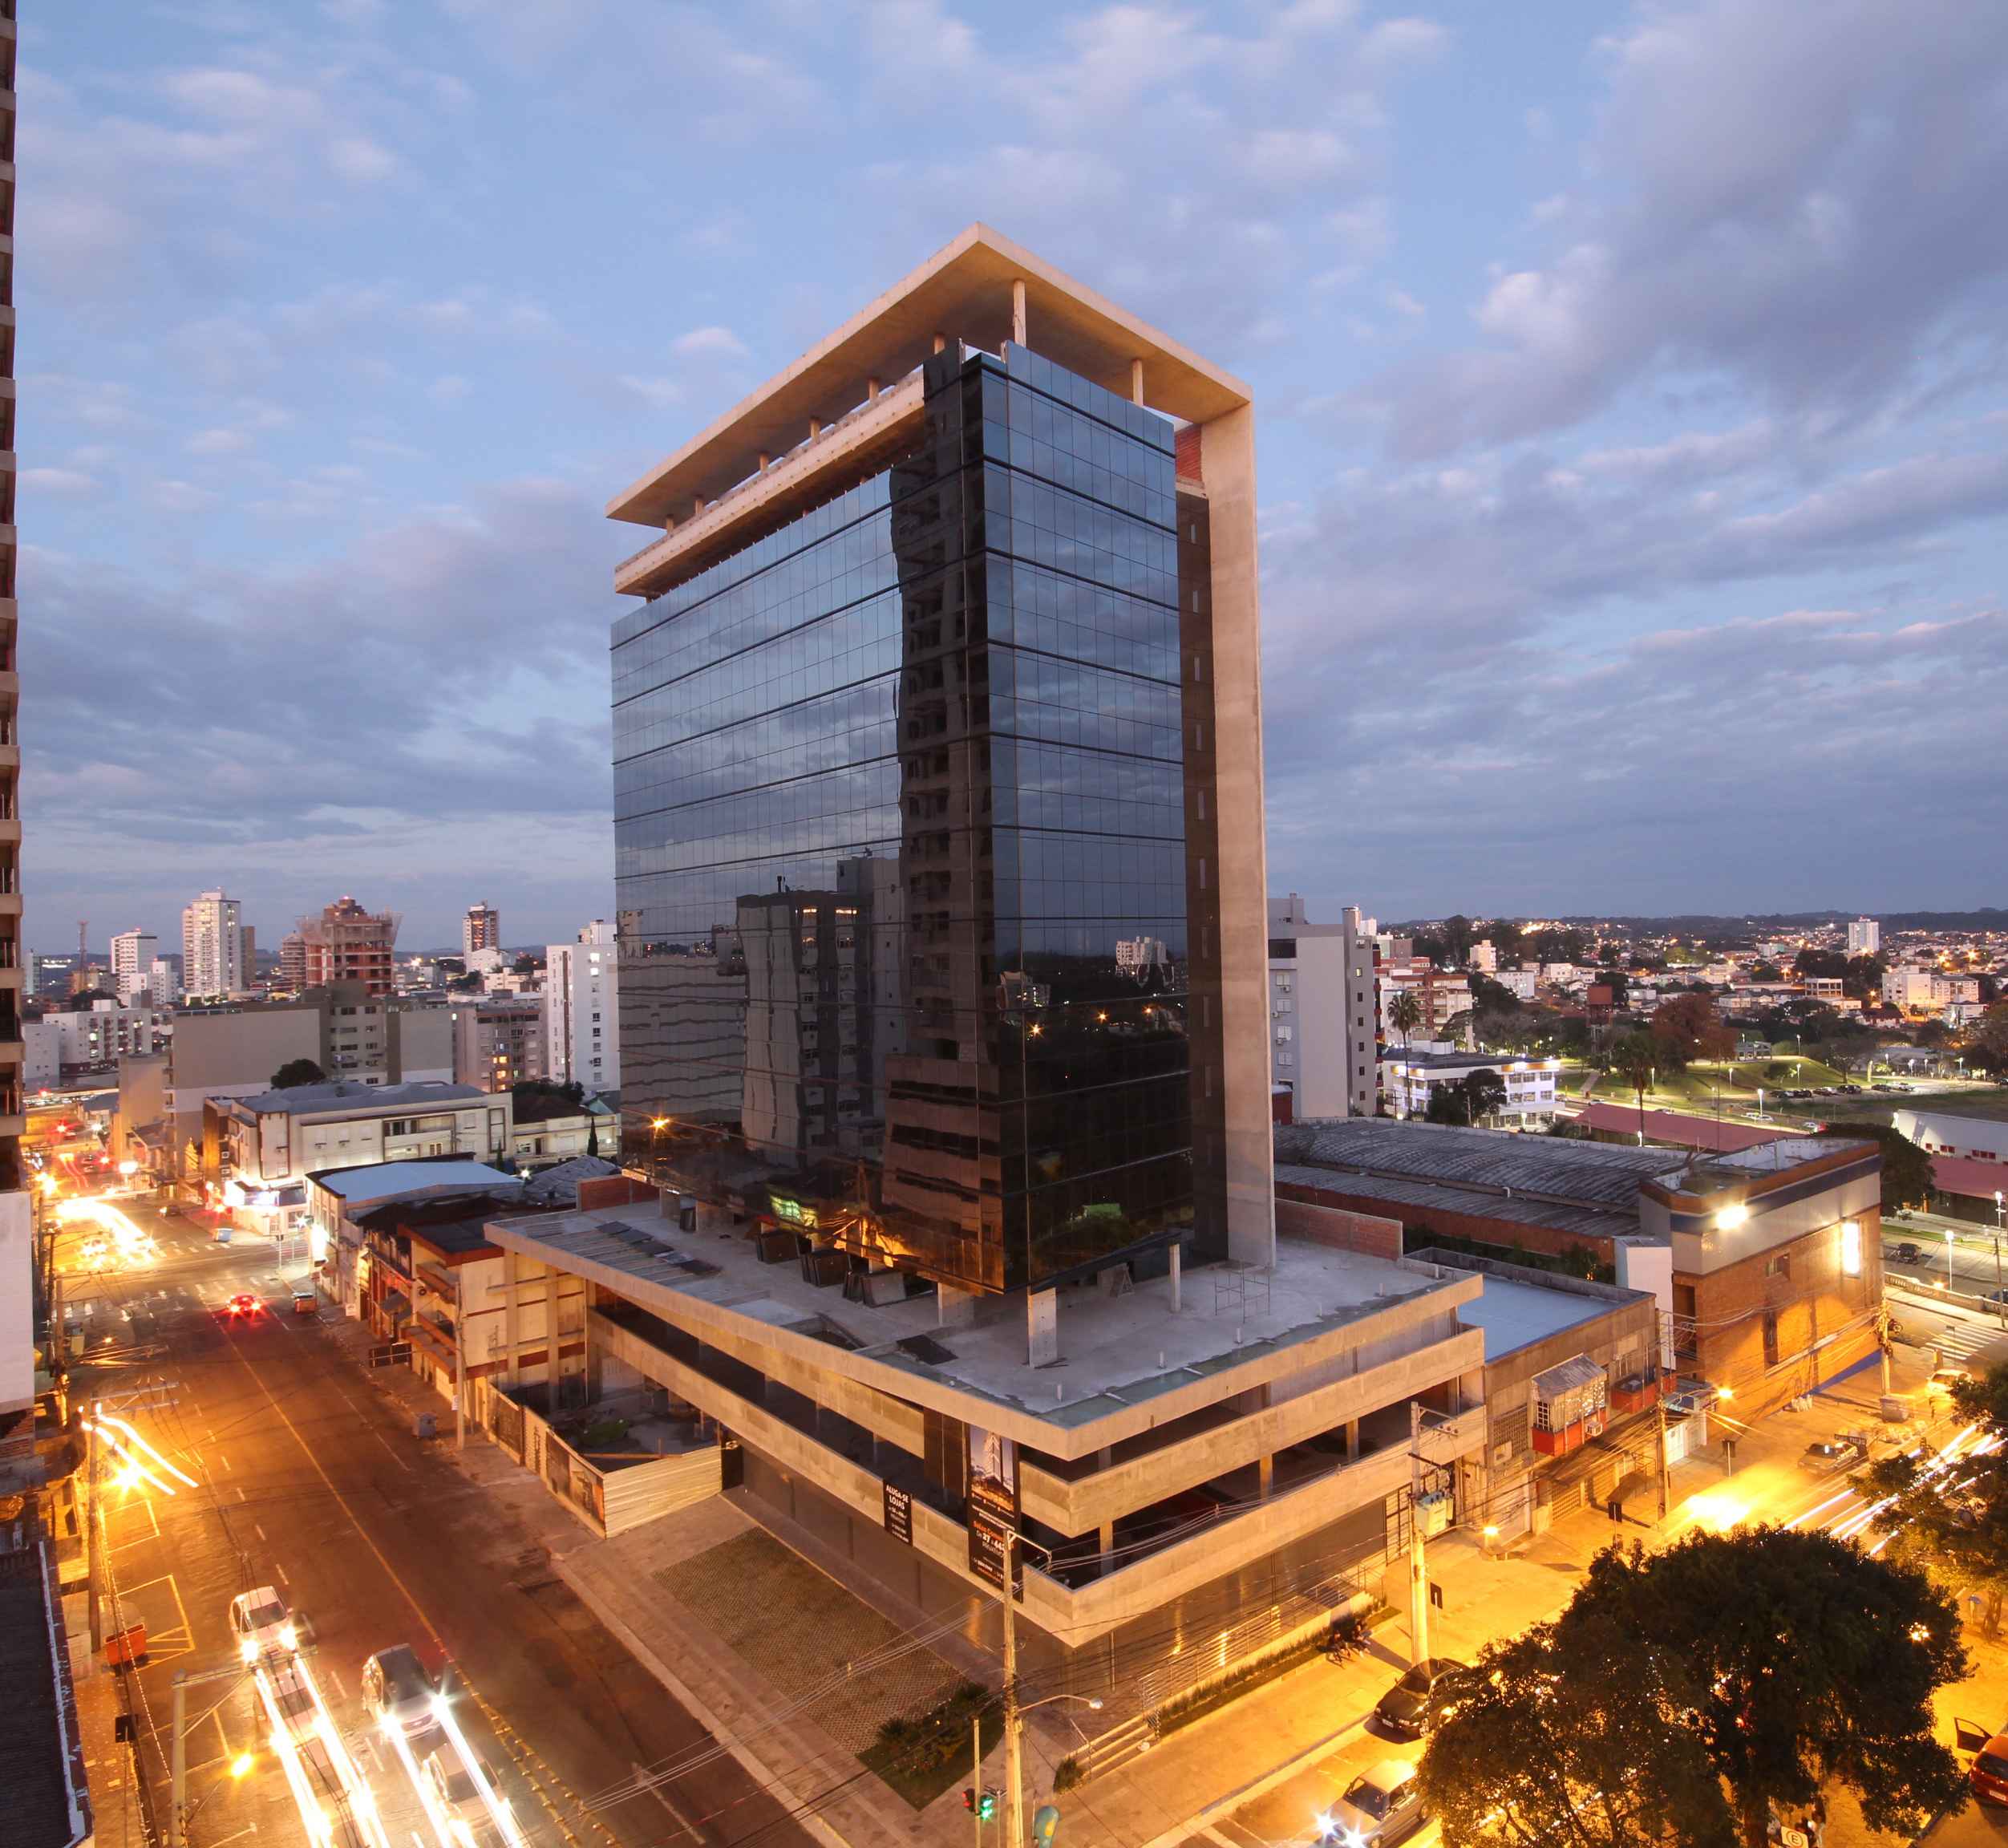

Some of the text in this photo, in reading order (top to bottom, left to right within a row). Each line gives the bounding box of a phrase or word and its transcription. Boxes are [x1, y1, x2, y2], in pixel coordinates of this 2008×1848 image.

[886, 1484, 909, 1503] ALUGA-SE
[889, 1494, 905, 1510] LOJAS
[1791, 1834, 1799, 1845] E
